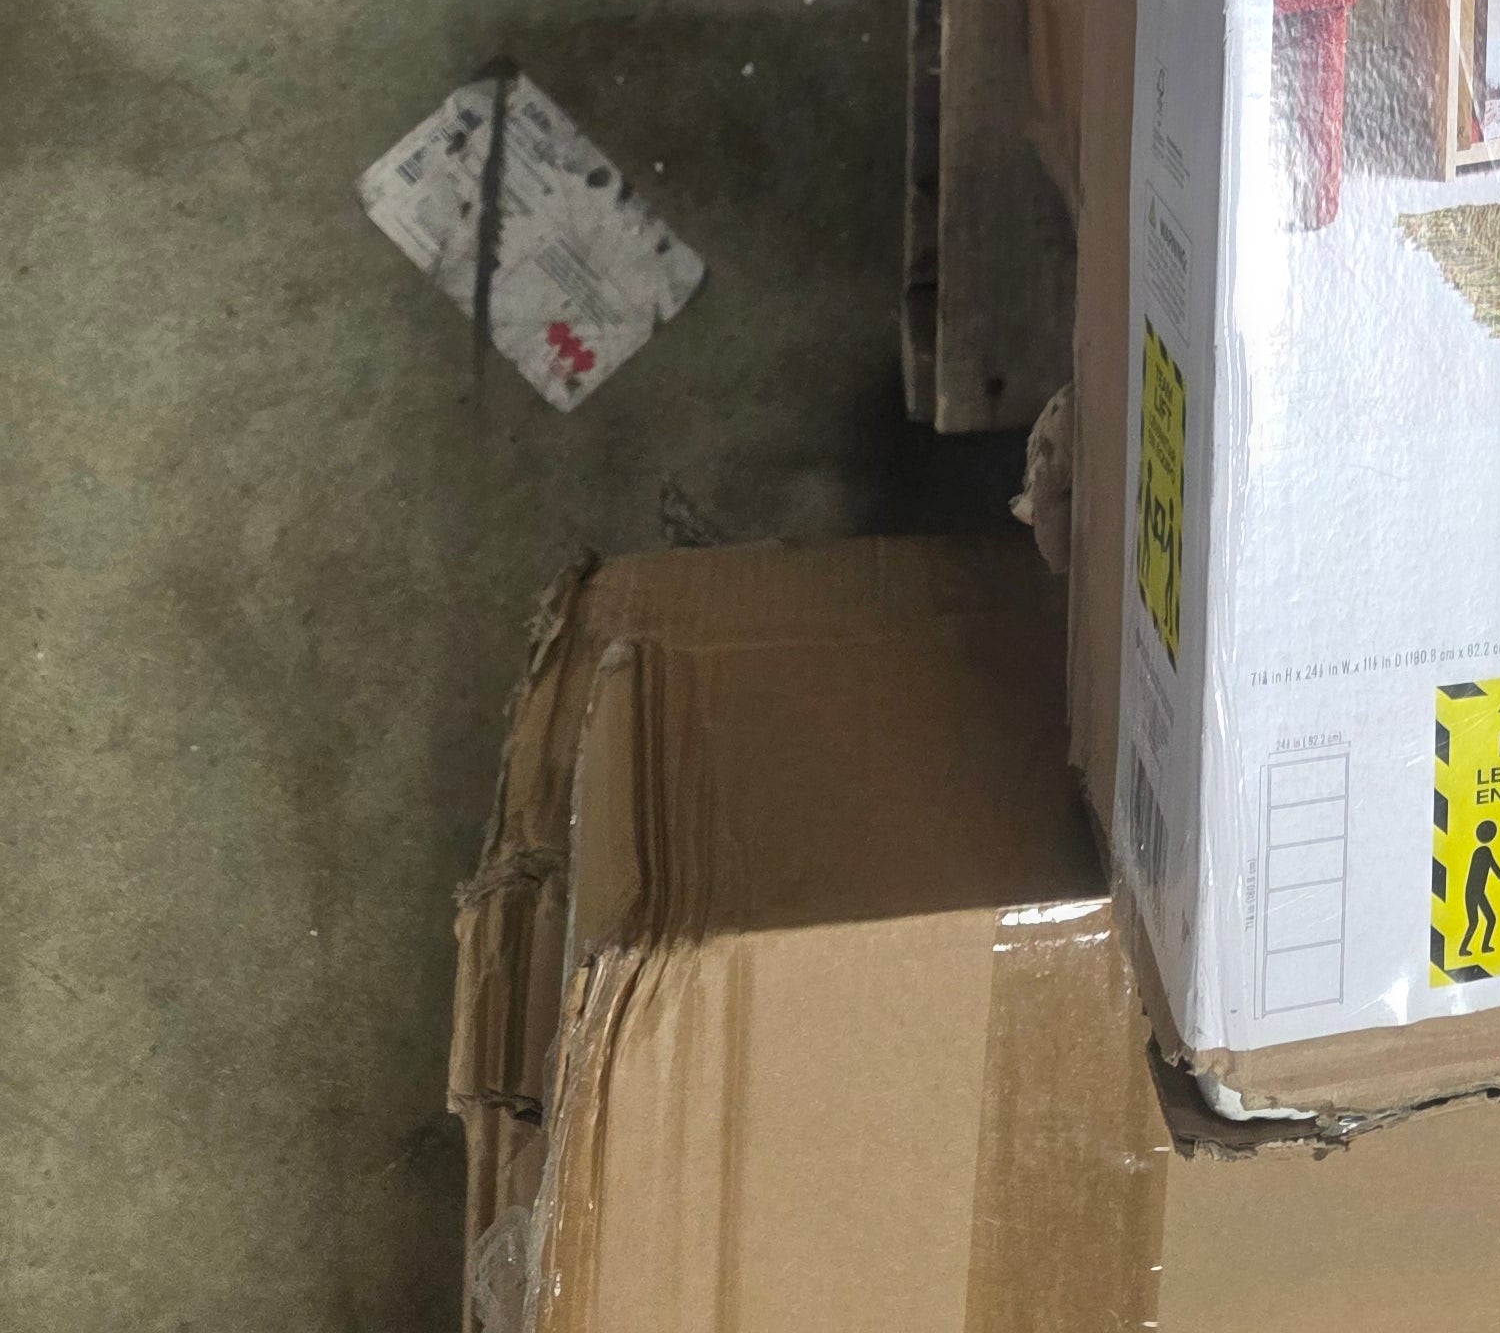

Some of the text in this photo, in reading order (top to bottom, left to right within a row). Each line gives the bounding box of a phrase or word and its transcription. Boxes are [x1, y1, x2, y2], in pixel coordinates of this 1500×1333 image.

[1285, 667, 1292, 683] H
[1328, 663, 1338, 677] in
[1341, 659, 1351, 675] W
[1439, 650, 1455, 662] cm
[1458, 648, 1464, 659] x
